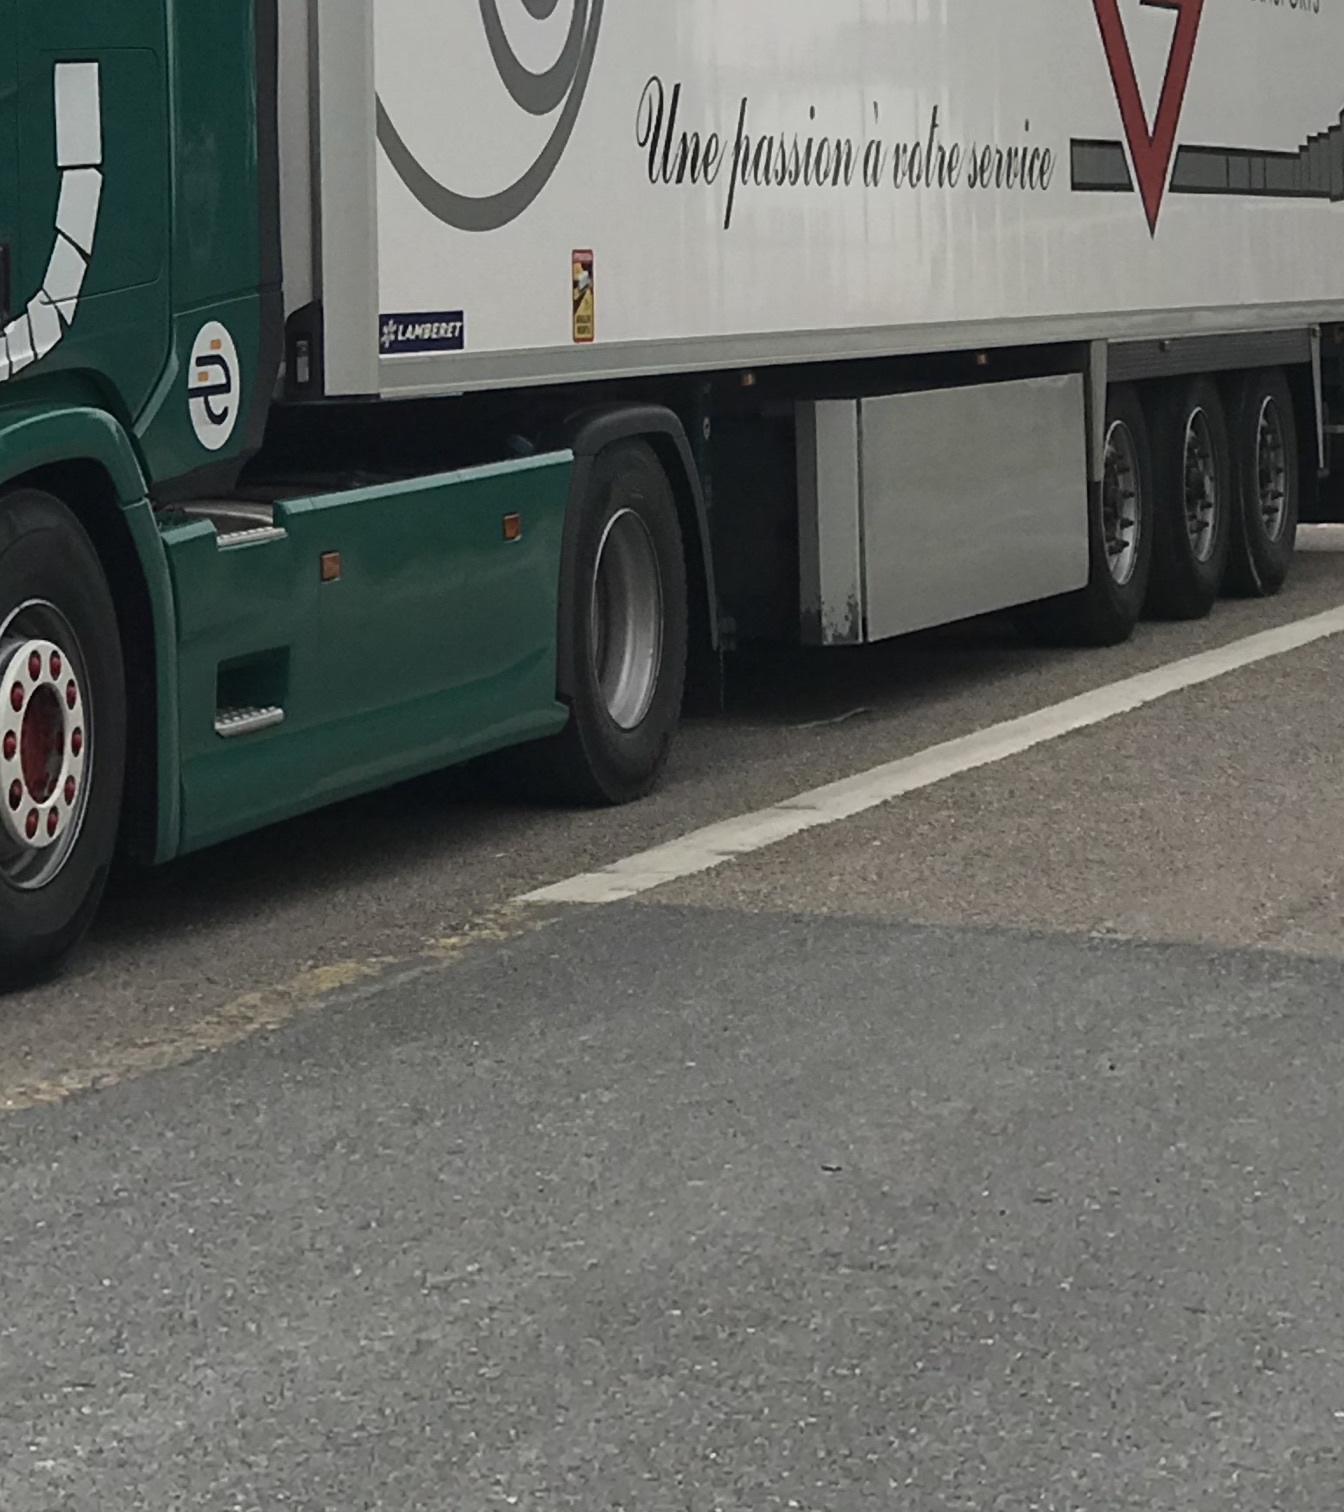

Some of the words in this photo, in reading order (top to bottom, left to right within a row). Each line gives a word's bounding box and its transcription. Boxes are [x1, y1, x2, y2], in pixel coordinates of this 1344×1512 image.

[636, 74, 727, 186] Une
[723, 96, 858, 231] passion
[862, 100, 888, 189] à
[892, 104, 964, 189] votre
[966, 118, 1057, 191] service
[397, 321, 463, 341] LAMBERET
